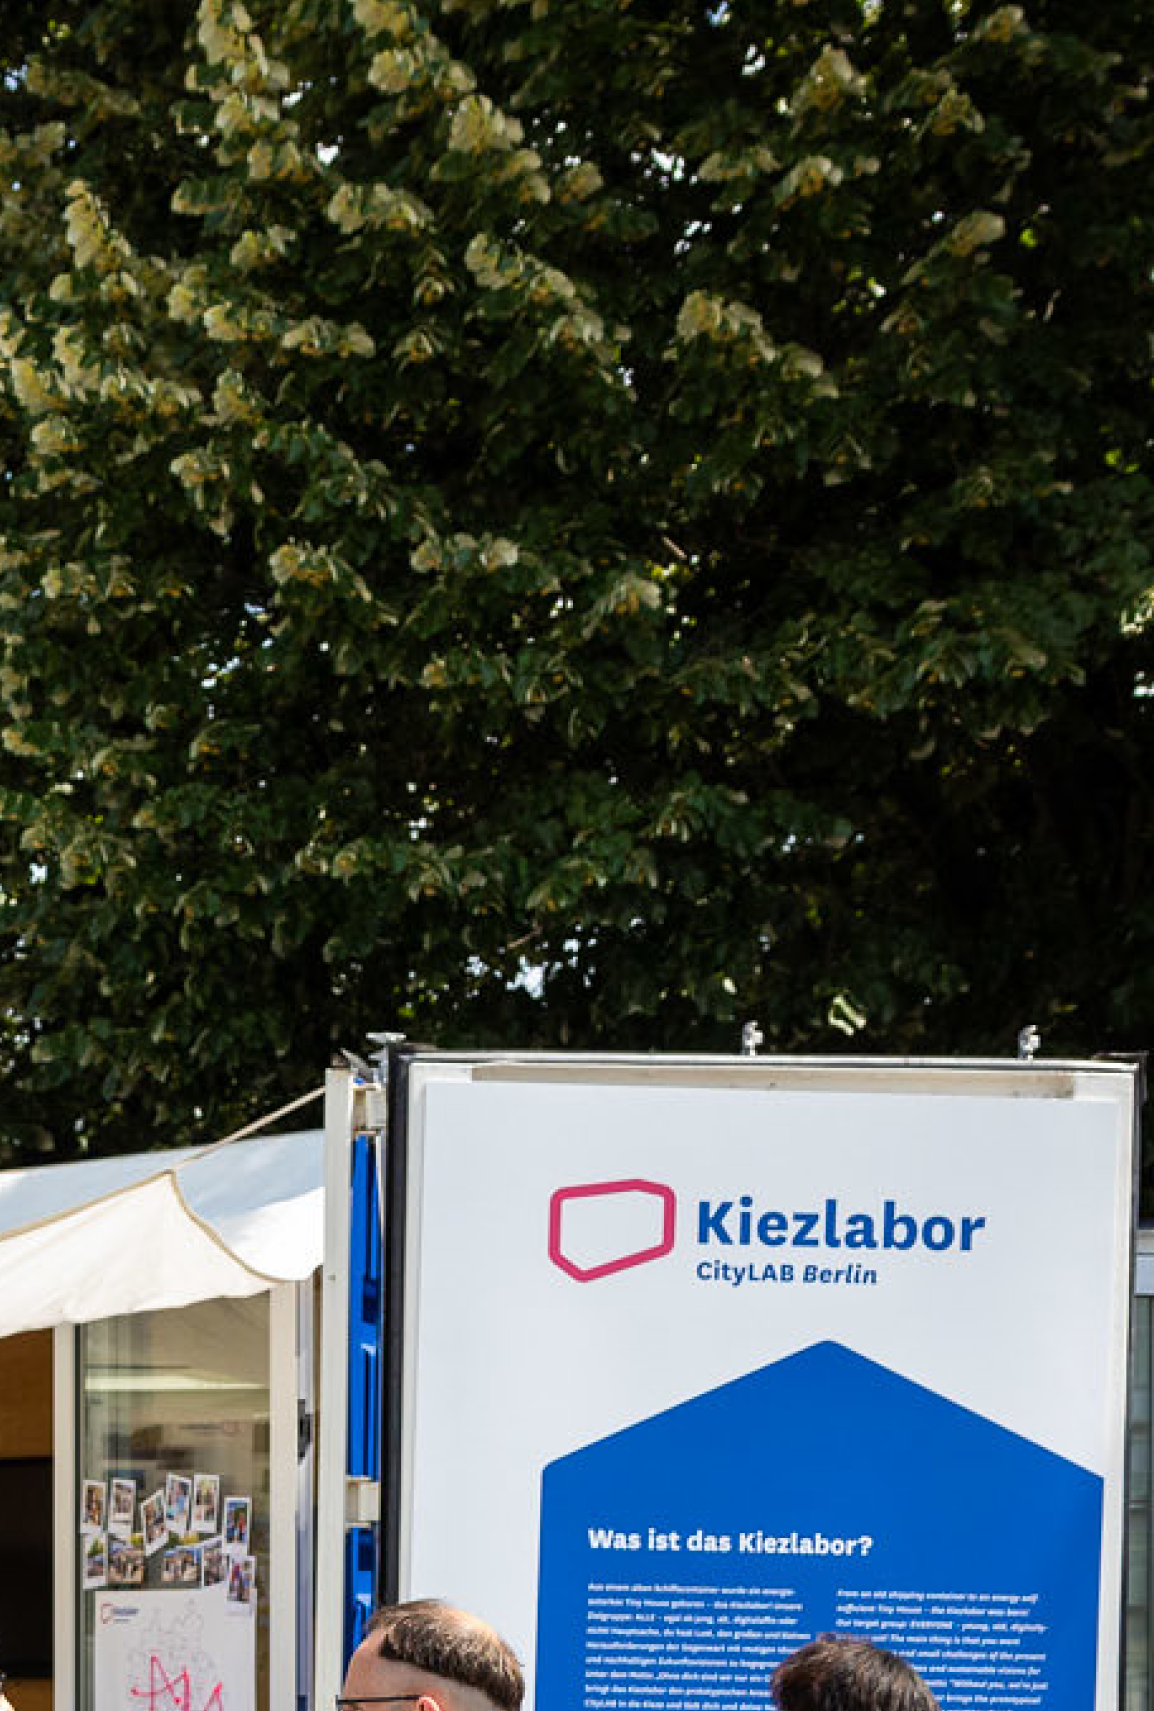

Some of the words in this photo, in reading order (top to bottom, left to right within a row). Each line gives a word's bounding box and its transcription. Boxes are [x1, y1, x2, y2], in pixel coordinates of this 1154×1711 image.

[698, 1195, 986, 1251] Kiezlabor
[696, 1259, 794, 1287] CityLAB
[802, 1263, 877, 1285] Berlin
[587, 1528, 642, 1551] Was
[648, 1527, 680, 1552] ist
[686, 1528, 733, 1553] das
[738, 1530, 873, 1557] Kiezlabor?
